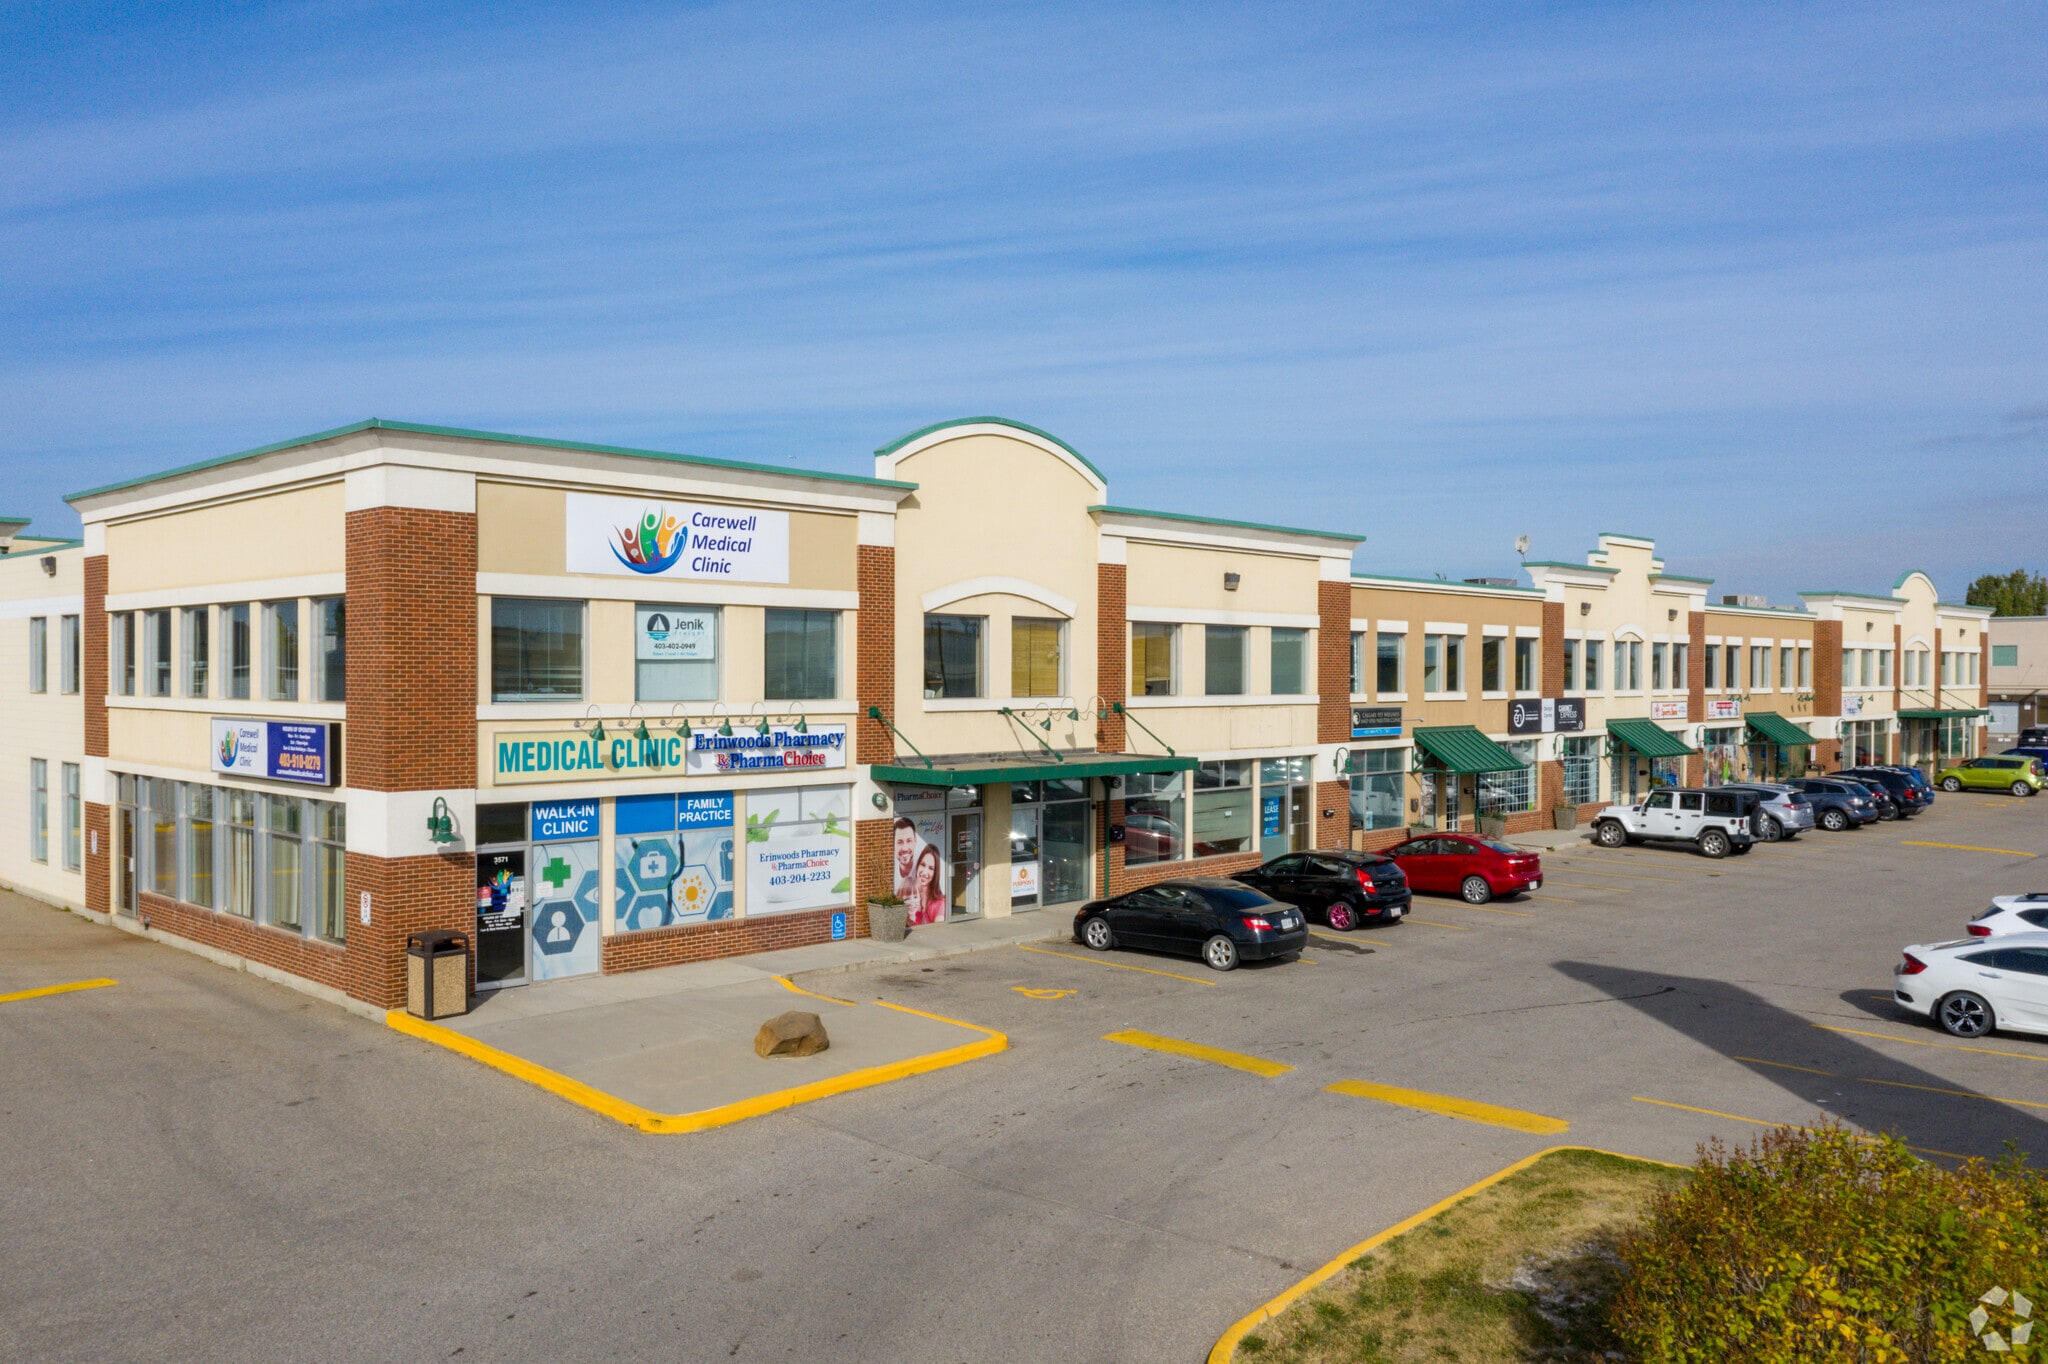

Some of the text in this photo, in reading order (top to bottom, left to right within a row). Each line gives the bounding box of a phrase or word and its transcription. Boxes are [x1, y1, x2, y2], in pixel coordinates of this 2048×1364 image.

[692, 512, 757, 531] Carewell
[692, 534, 752, 552] Medical
[692, 556, 732, 573] Clinic
[675, 618, 704, 630] Jenik
[240, 728, 259, 739] Carewell
[694, 731, 845, 750] Erinwoods Pharmacy
[240, 742, 257, 753] Medical
[499, 737, 681, 773] MEDICAL CLINIC
[240, 756, 252, 767] Clinic
[687, 798, 725, 810] FAMILY
[1264, 804, 1279, 814] LEASE
[535, 804, 595, 821] WALK-IN
[679, 809, 732, 823] PRACTICE
[543, 819, 589, 836] CLINIC
[759, 848, 840, 862] Erinwoods Pharmacy
[769, 870, 831, 886] 403-204-2233
